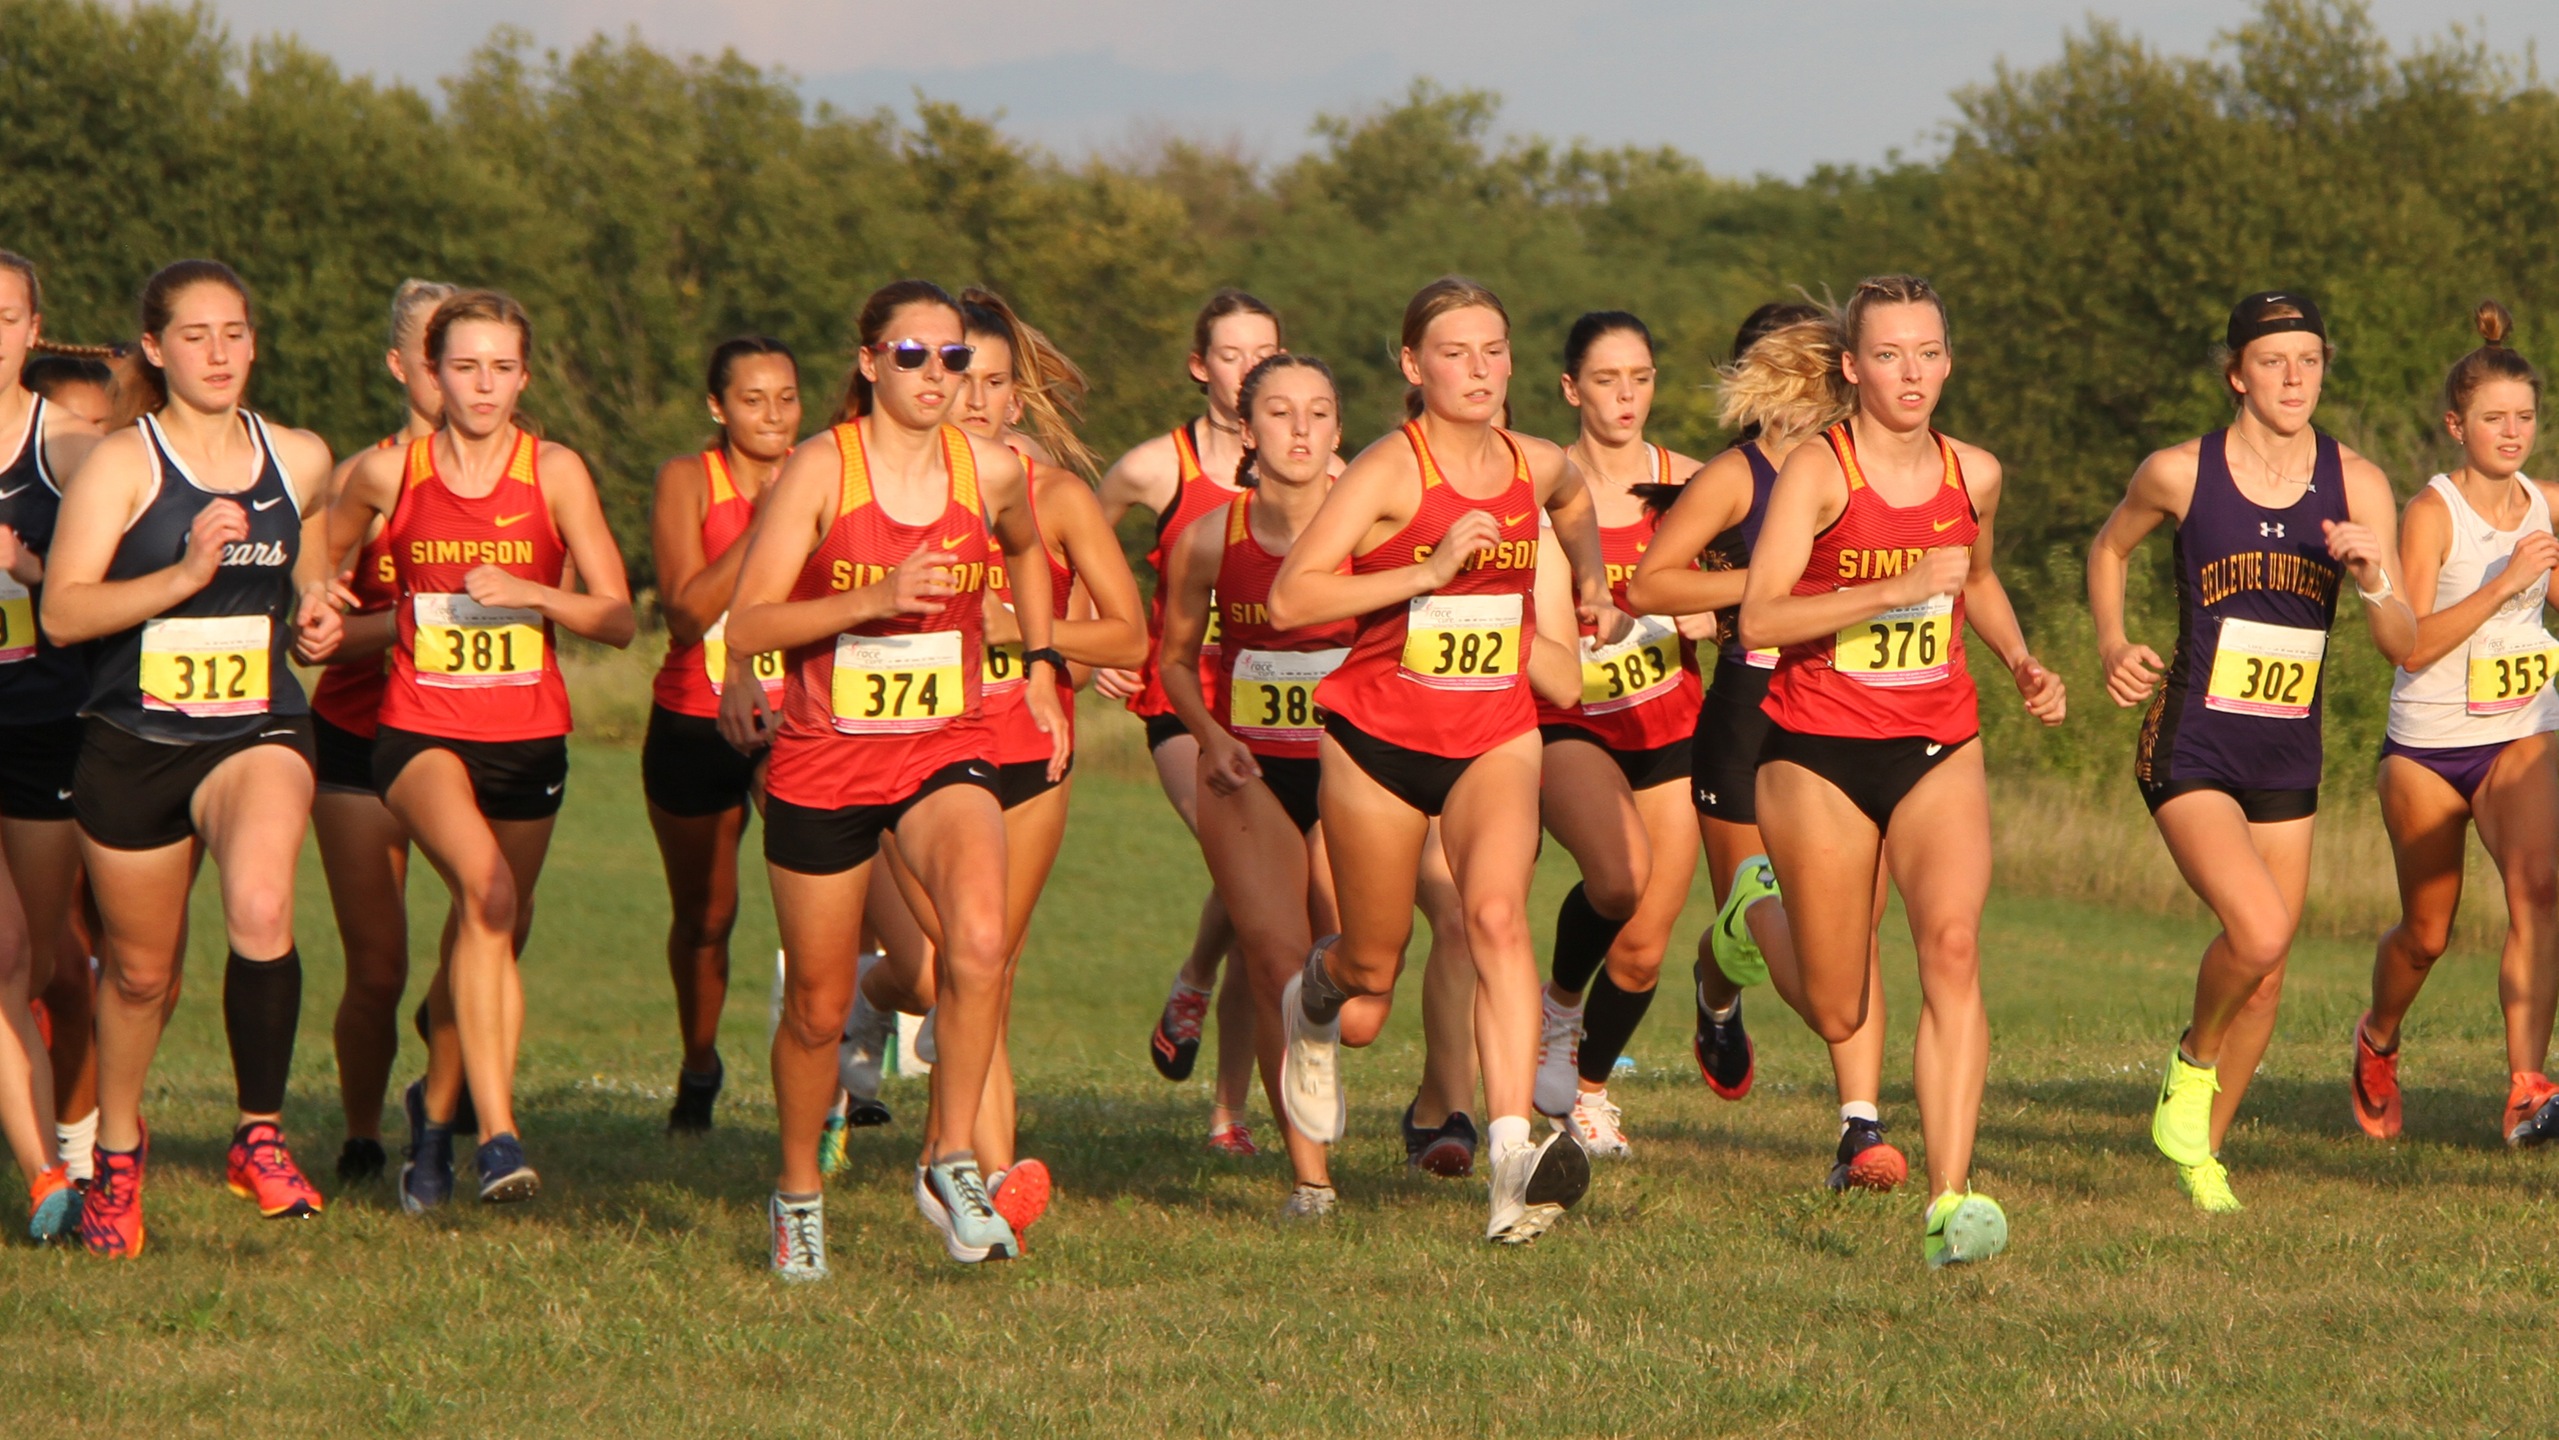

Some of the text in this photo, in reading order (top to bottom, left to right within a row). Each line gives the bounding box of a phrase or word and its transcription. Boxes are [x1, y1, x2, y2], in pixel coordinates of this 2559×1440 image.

[200, 538, 288, 567] ears
[410, 540, 534, 565] SIMPSON
[1838, 546, 1972, 579] SIMP
[2201, 551, 2263, 607] BELLEVUE
[445, 629, 515, 672] 381
[1432, 631, 1503, 675] 382
[1869, 620, 1936, 670] 376
[174, 654, 247, 700] 312
[863, 672, 938, 717] 374
[1601, 646, 1666, 698] 383
[2239, 657, 2304, 703] 302
[2495, 653, 2549, 698] 353
